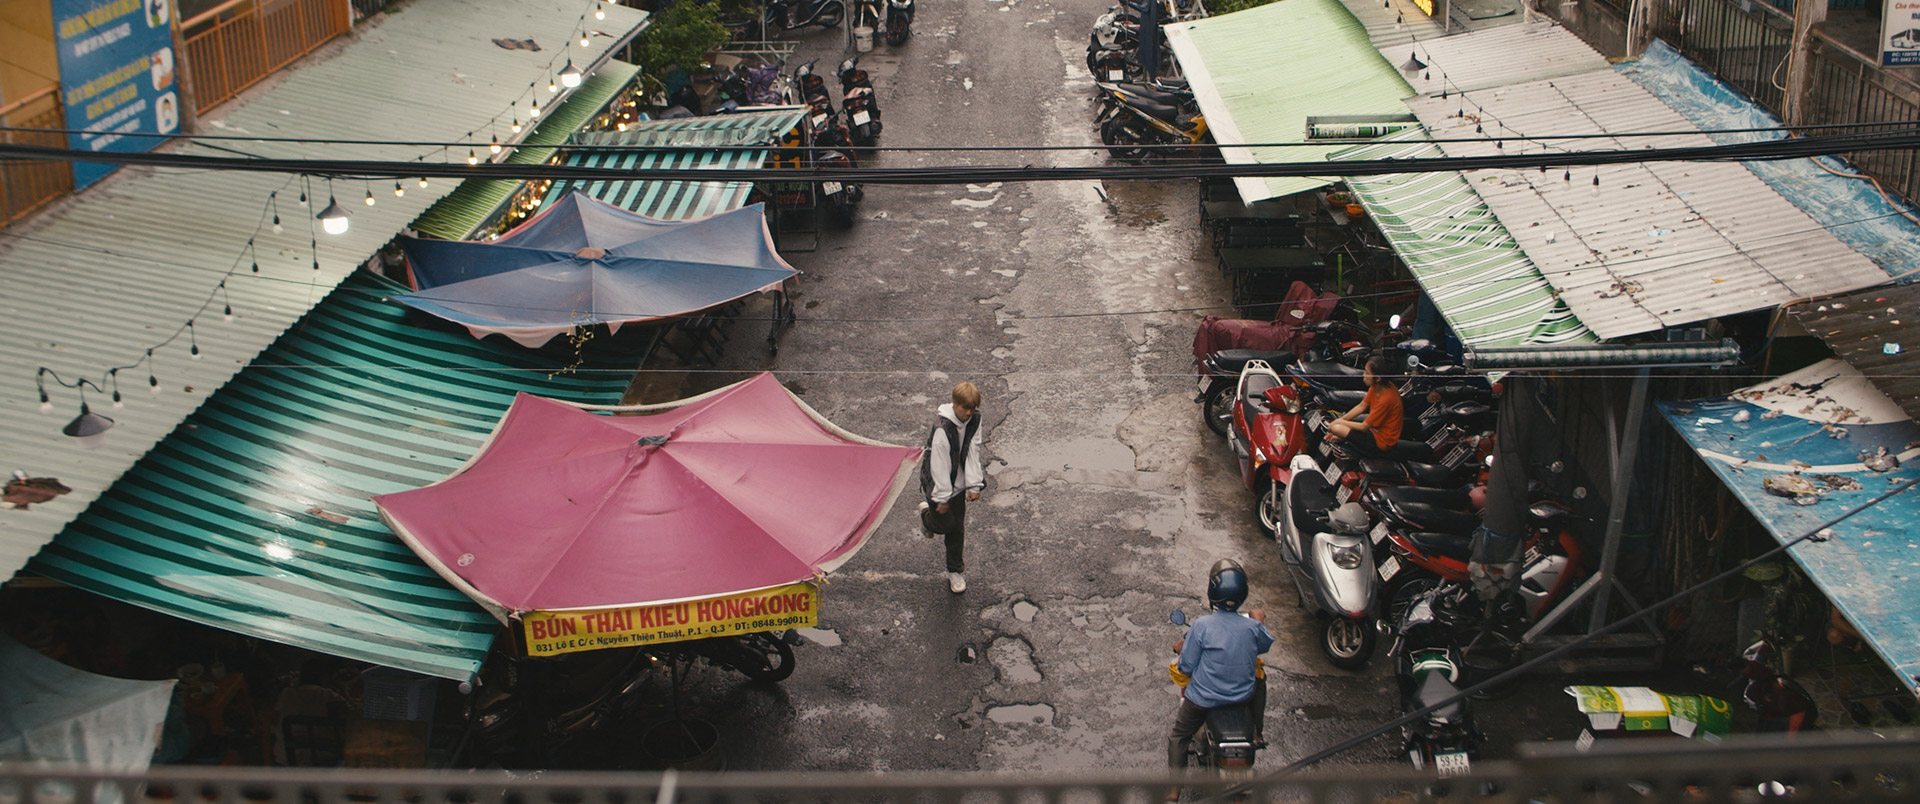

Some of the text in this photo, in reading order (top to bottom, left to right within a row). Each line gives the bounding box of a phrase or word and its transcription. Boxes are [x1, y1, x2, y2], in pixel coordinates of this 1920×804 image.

[531, 613, 577, 640] BÚN
[581, 608, 633, 634] THÁI
[697, 593, 810, 623] HONGKONG
[536, 644, 553, 652] 031
[569, 640, 576, 648] E
[578, 637, 594, 647] C/c
[597, 633, 629, 646] Nguyễn
[631, 632, 655, 642] Thiện
[687, 626, 702, 636] P.1
[711, 623, 726, 634] Q.3
[735, 621, 750, 631] ĐT:
[752, 615, 809, 629] 0848.990011
